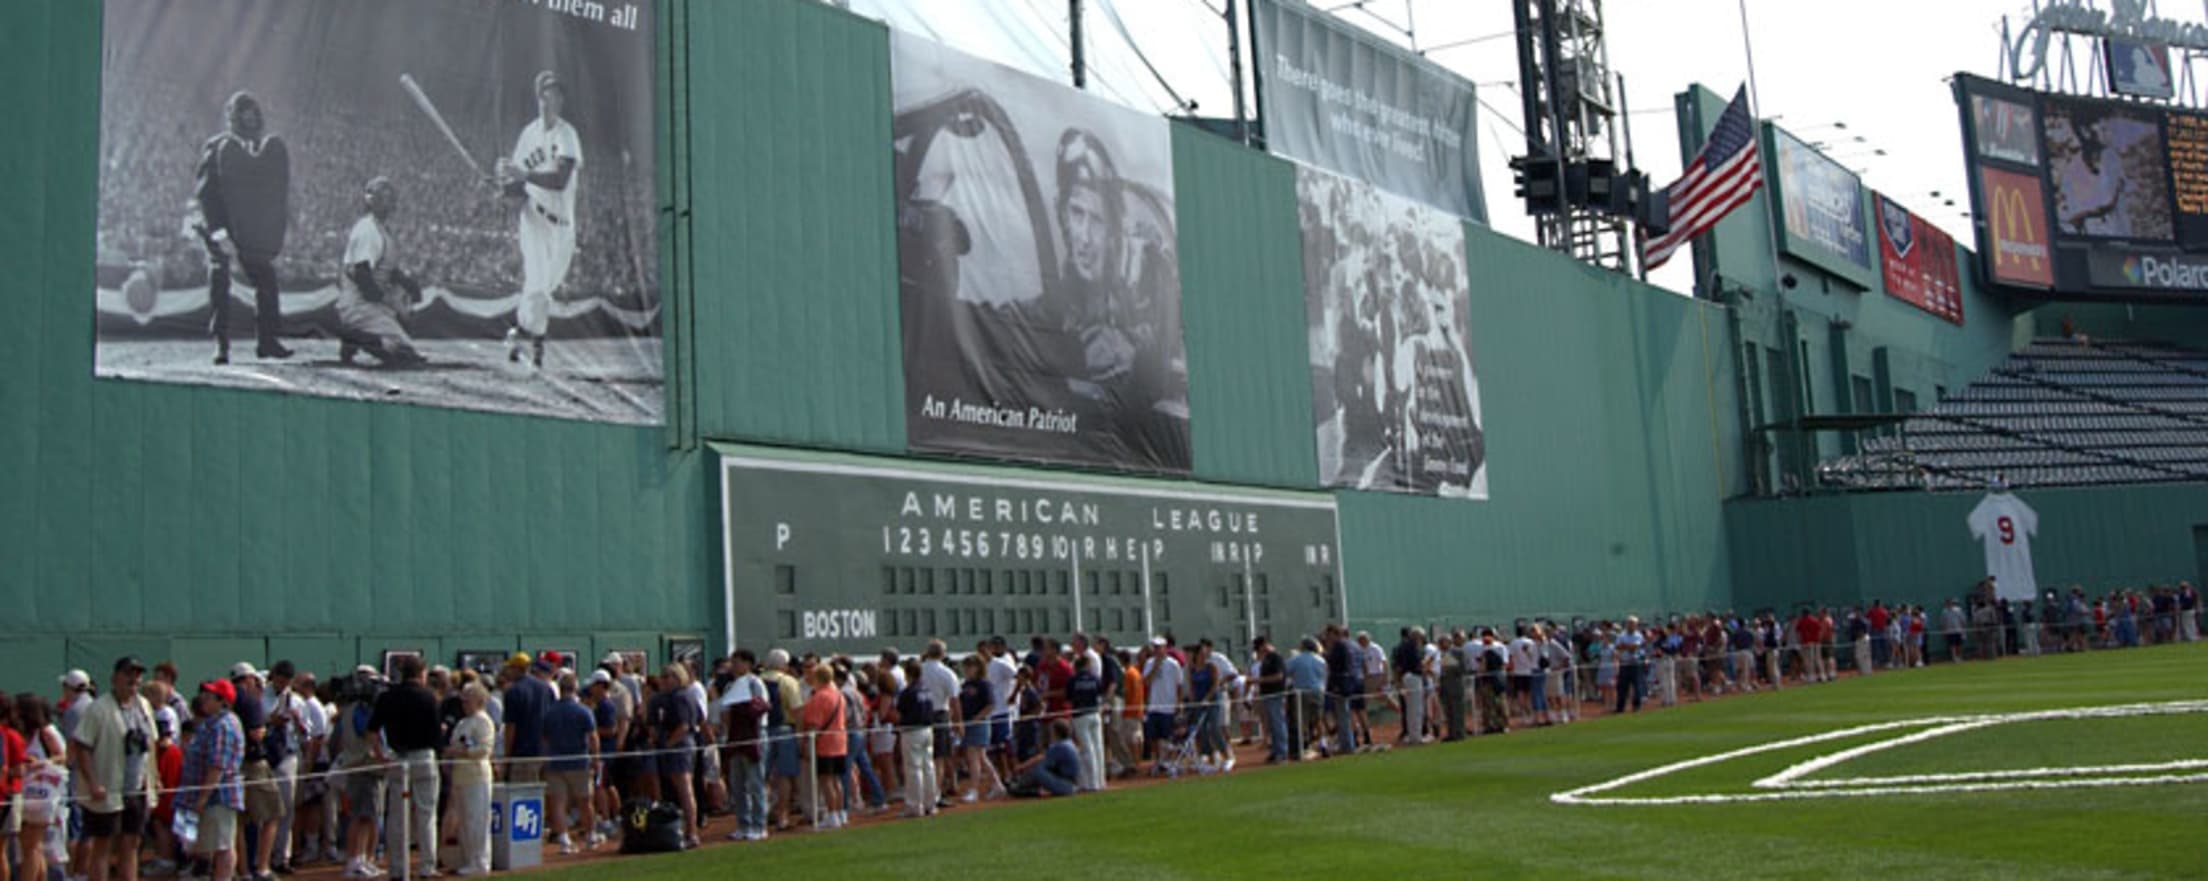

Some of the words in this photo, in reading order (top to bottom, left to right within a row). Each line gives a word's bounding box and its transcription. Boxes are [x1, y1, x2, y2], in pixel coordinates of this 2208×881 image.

[611, 4, 638, 30] all
[1277, 53, 1318, 91] There
[1354, 88, 1379, 114] the
[921, 393, 945, 418] An
[949, 397, 1025, 428] American
[1027, 405, 1077, 433] Patriot
[902, 491, 1099, 525] AMERICAN
[1153, 507, 1259, 533] LEAGUE
[1997, 516, 2015, 545] 9
[777, 523, 791, 550] P
[1052, 536, 1068, 559] 10
[1084, 537, 1096, 560] R
[1106, 538, 1118, 560] H
[1127, 538, 1137, 560] E
[1154, 540, 1164, 560] P
[803, 610, 877, 638] BOSTON
